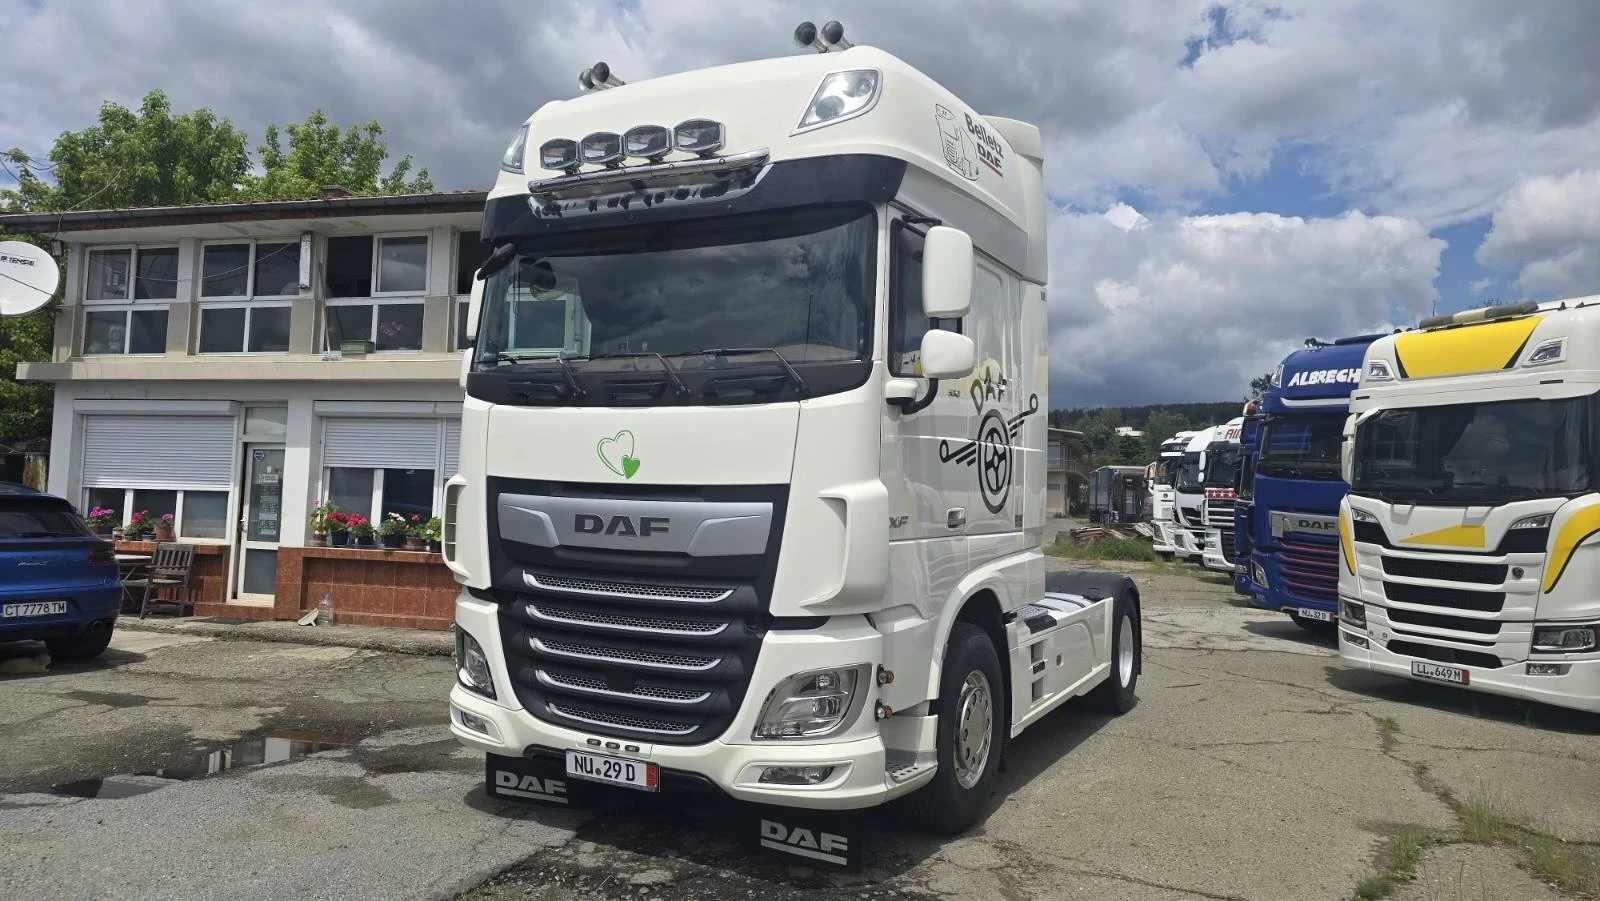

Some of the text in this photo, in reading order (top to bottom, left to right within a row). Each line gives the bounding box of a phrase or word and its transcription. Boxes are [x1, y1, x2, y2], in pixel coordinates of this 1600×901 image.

[964, 111, 1004, 159] Belletz
[977, 142, 1002, 169] DAF
[970, 366, 1007, 416] DAF
[574, 513, 670, 537] DAF
[889, 515, 910, 529] XF
[1298, 519, 1336, 530] DAF
[5, 602, 65, 616] CT 7778 TM
[1417, 663, 1461, 681] LL 649 M
[574, 754, 594, 775] NU
[603, 760, 622, 780] 29
[625, 763, 636, 782] D
[495, 769, 567, 794] DAF
[760, 818, 848, 853] DAF
